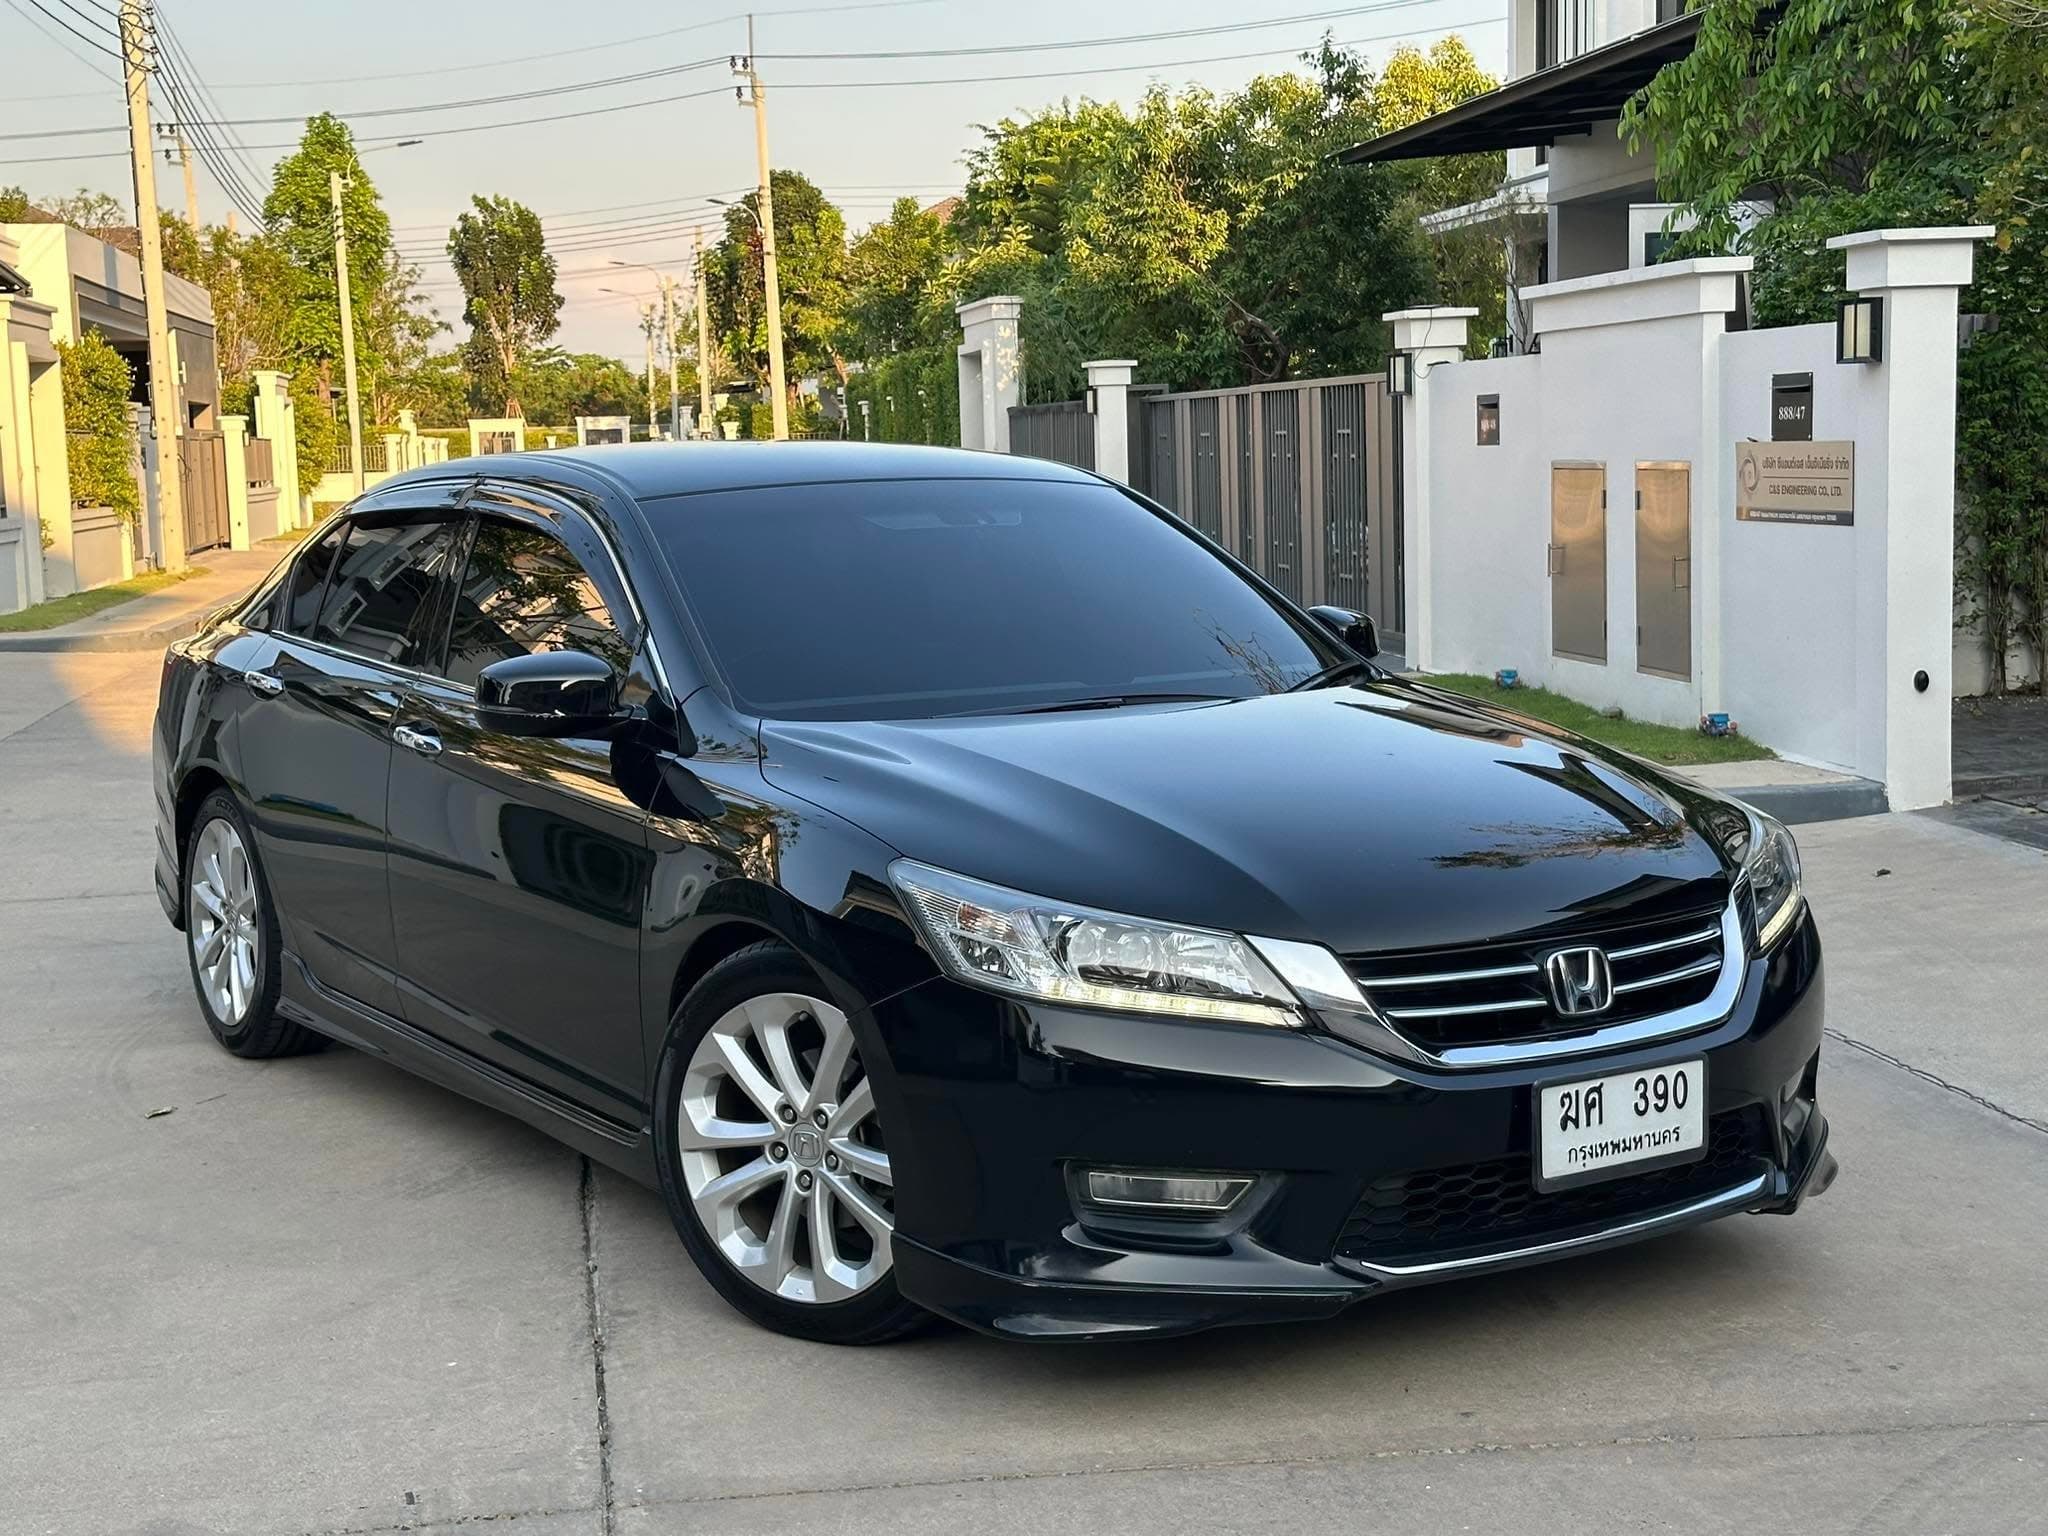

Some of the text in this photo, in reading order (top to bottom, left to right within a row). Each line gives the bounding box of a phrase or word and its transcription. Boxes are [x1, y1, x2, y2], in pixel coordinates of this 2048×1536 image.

[1778, 406, 1806, 421] 888/47
[1762, 456, 1776, 469] บริษัท
[1769, 484, 1781, 495] C&S
[1781, 485, 1818, 496] ENGINEERING
[1830, 486, 1842, 497] LTD.
[1633, 1070, 1689, 1117] 390
[1567, 1126, 1681, 1168] กรุงเทพมหานคร
